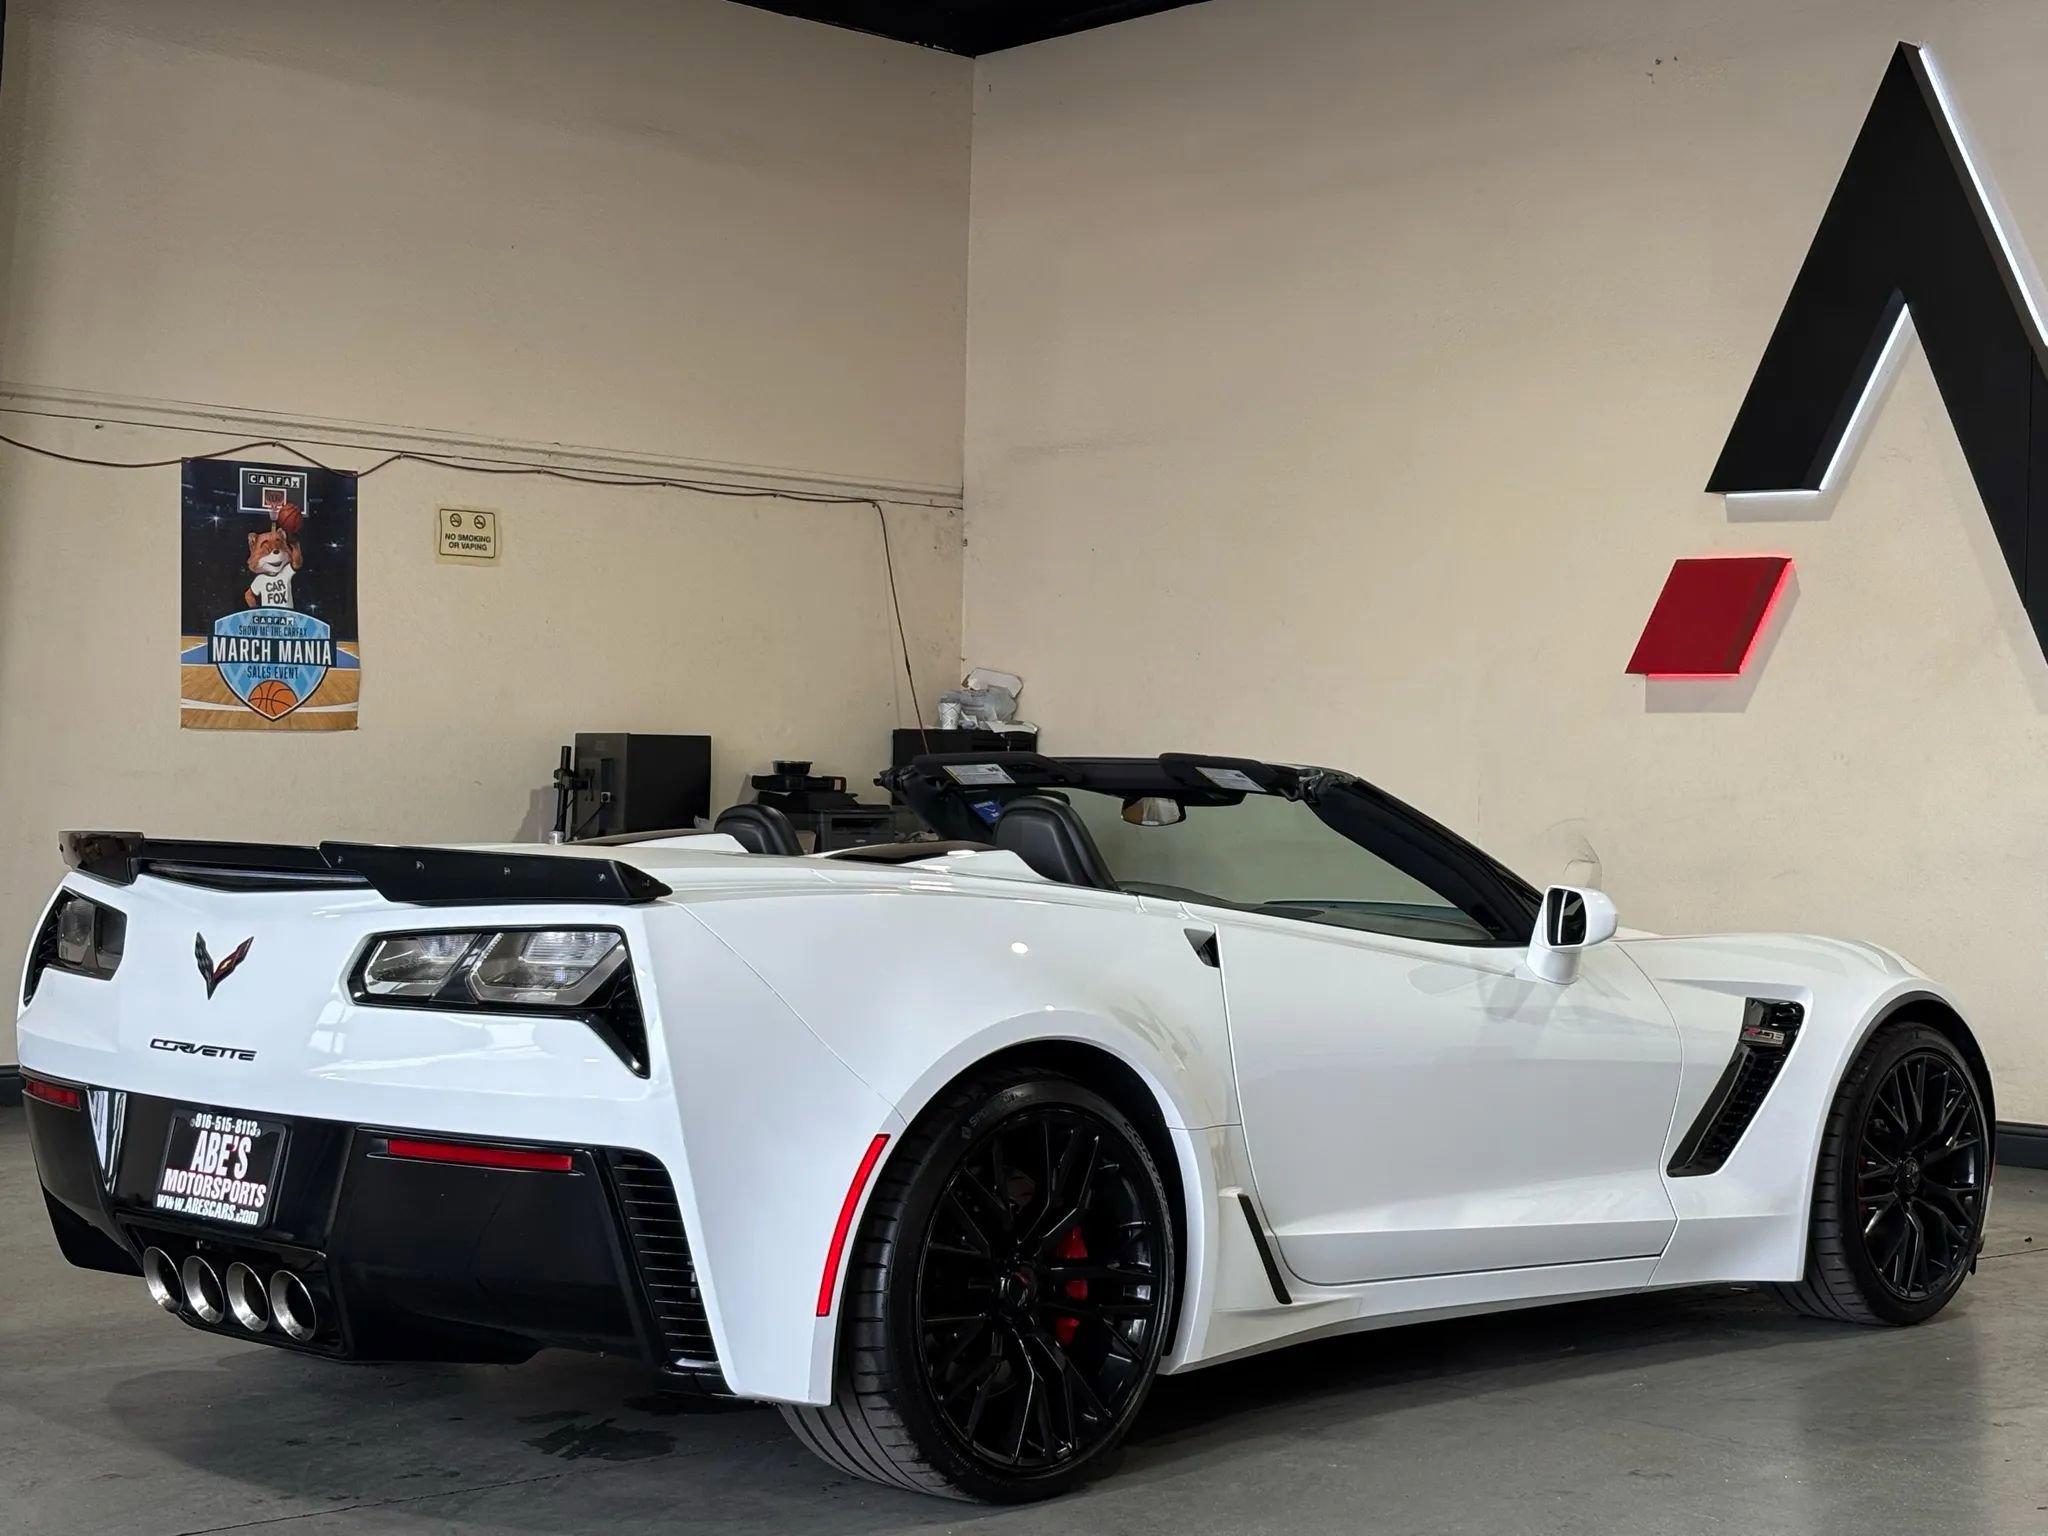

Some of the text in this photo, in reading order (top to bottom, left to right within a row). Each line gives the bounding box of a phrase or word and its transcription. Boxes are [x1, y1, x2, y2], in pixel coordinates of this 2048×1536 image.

[248, 474, 300, 488] CARFAX
[445, 533, 491, 543] NO SMOKING
[448, 541, 487, 551] OR VAPING
[265, 579, 286, 592] CAR
[267, 591, 287, 604] FOX
[253, 616, 294, 625] CARFAX
[239, 625, 307, 638] SHOW ME THE CARFAX
[213, 636, 332, 665] MARCH MANIA
[247, 665, 299, 679] SALES EVENT
[150, 1038, 257, 1061] CORVETTE
[190, 1129, 252, 1179] ABE'S
[162, 1168, 267, 1208] MOTORSPORTS
